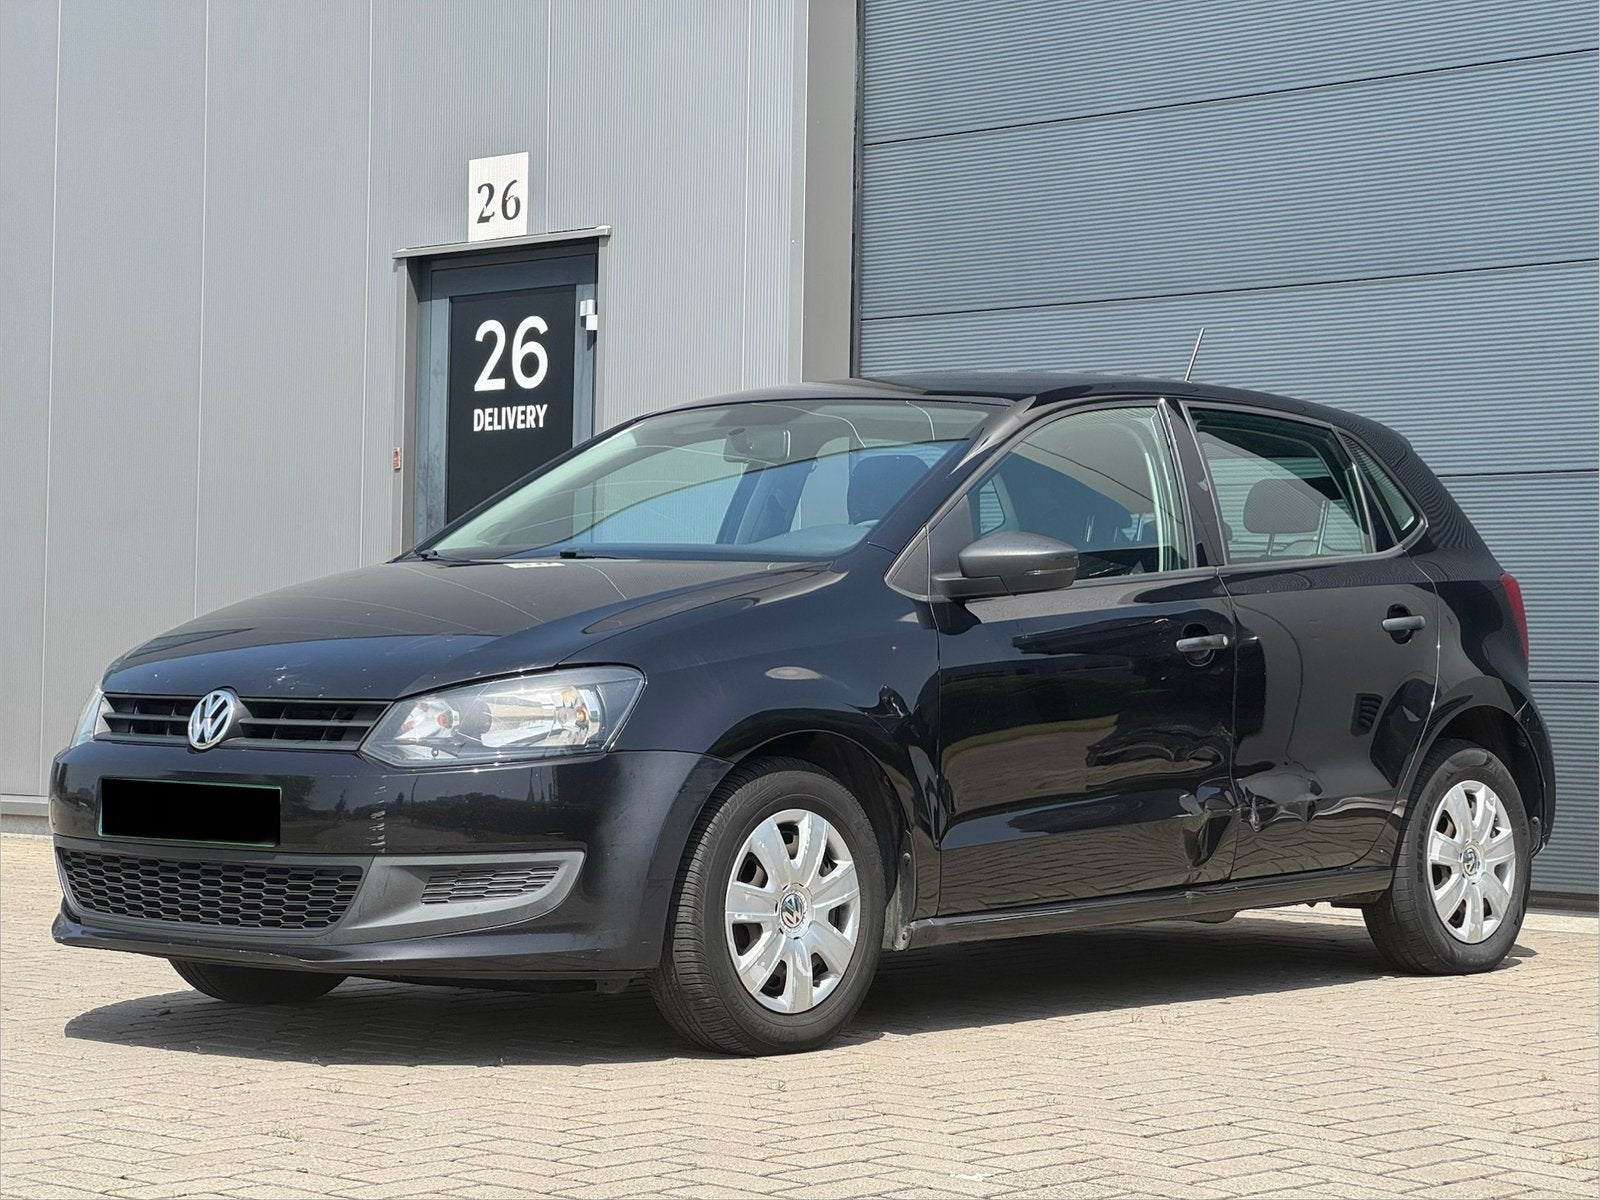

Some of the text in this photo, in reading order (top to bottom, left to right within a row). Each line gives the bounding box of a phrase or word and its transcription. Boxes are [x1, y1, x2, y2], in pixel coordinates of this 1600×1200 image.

[477, 179, 521, 224] 26
[474, 315, 549, 392] 26
[473, 404, 548, 432] DELIVERY
[188, 690, 234, 749] VW
